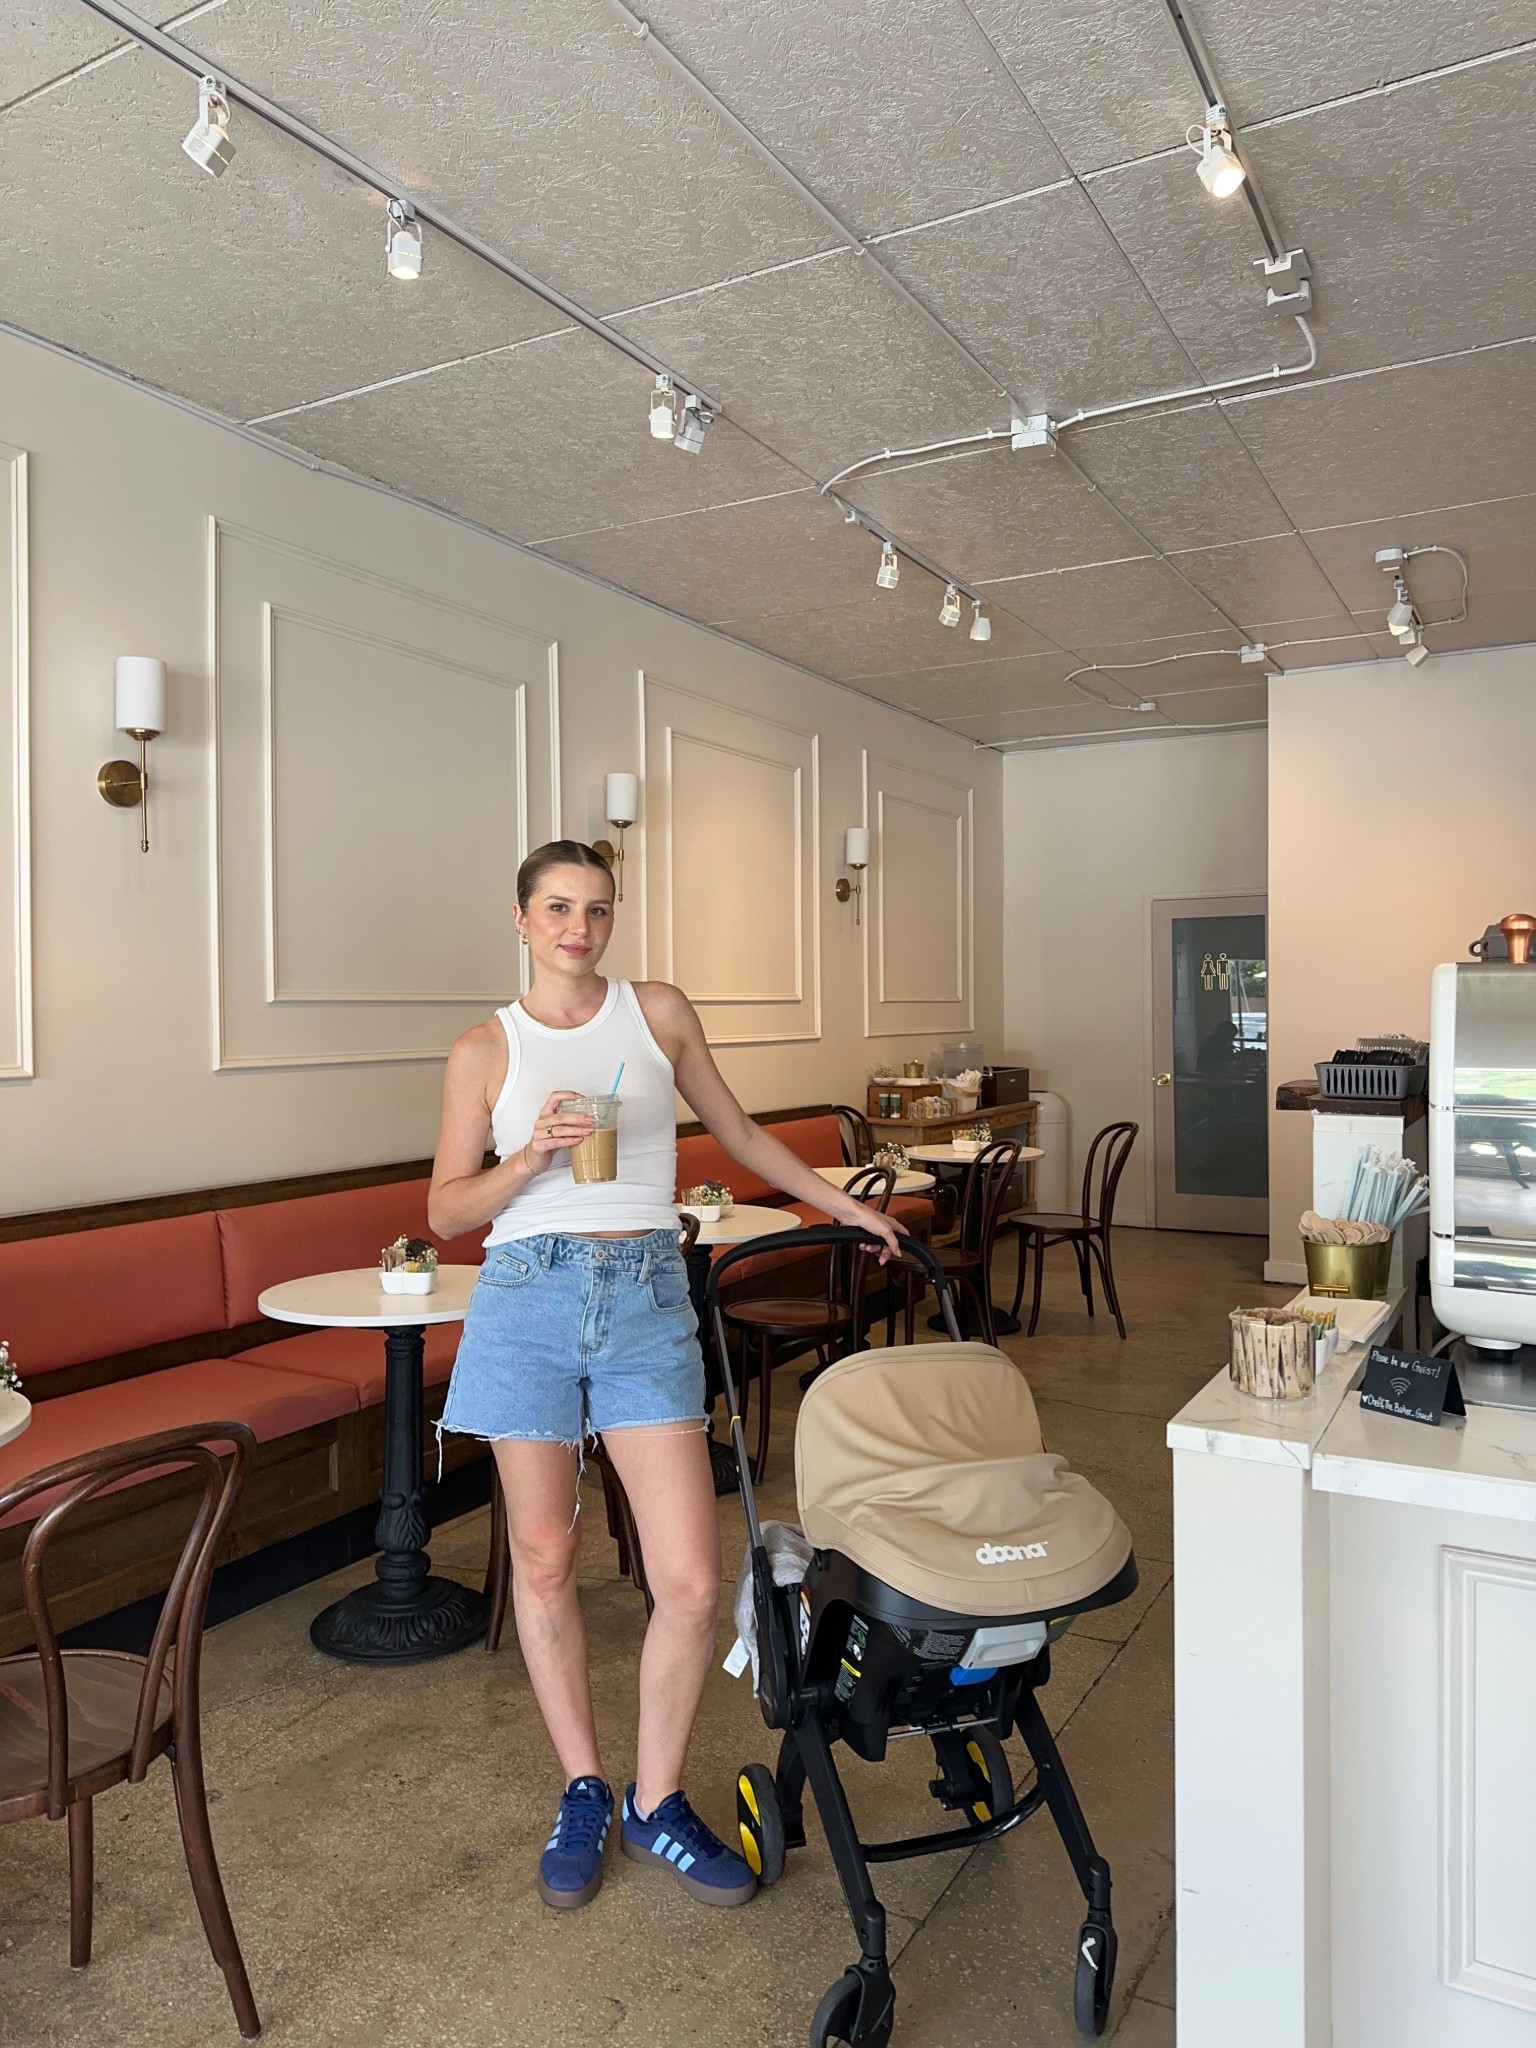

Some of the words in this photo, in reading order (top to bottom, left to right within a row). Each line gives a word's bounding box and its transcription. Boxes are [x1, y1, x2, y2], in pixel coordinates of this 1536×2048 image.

[1370, 1350, 1389, 1364] Please
[1390, 1355, 1398, 1366] be
[976, 1543, 1047, 1565] doona
